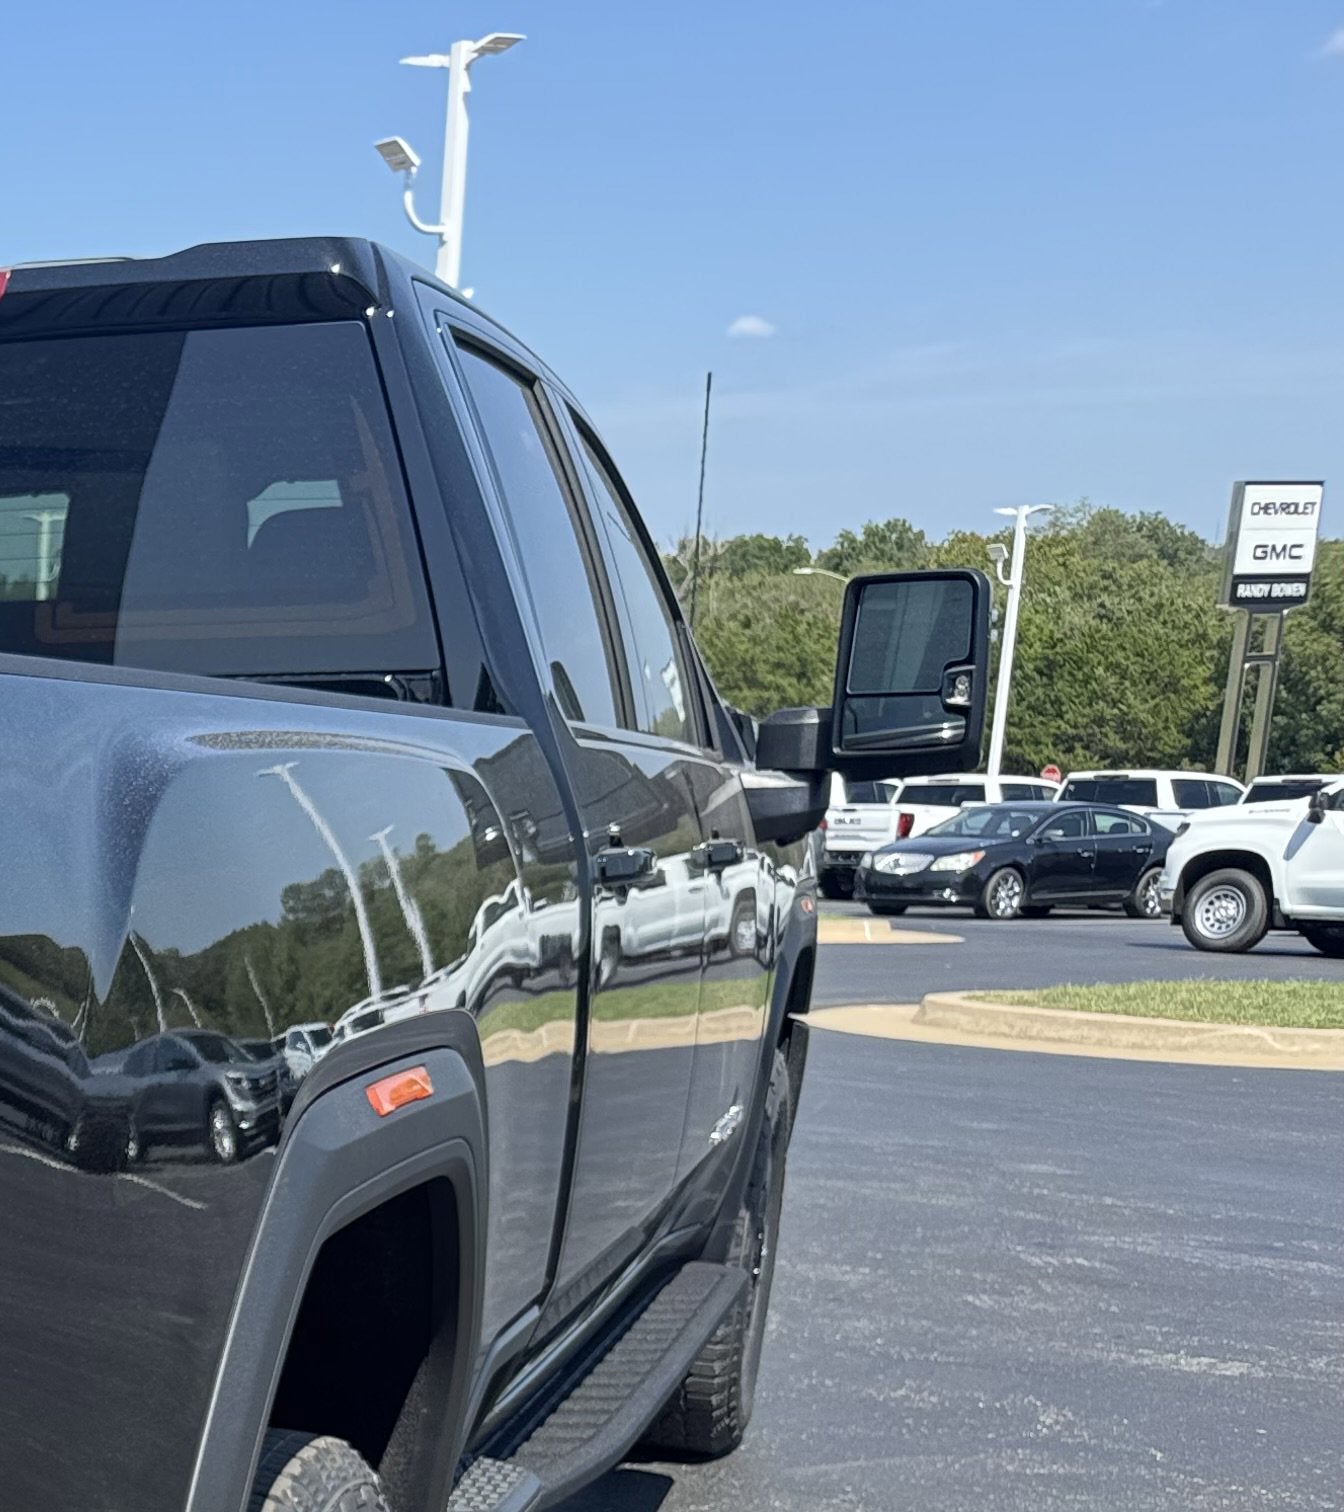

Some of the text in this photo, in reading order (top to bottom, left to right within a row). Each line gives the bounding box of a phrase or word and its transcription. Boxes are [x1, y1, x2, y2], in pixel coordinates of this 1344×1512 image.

[1251, 502, 1316, 516] CHEVROLET
[1253, 544, 1304, 560] GMC
[1236, 583, 1270, 598] RANDY
